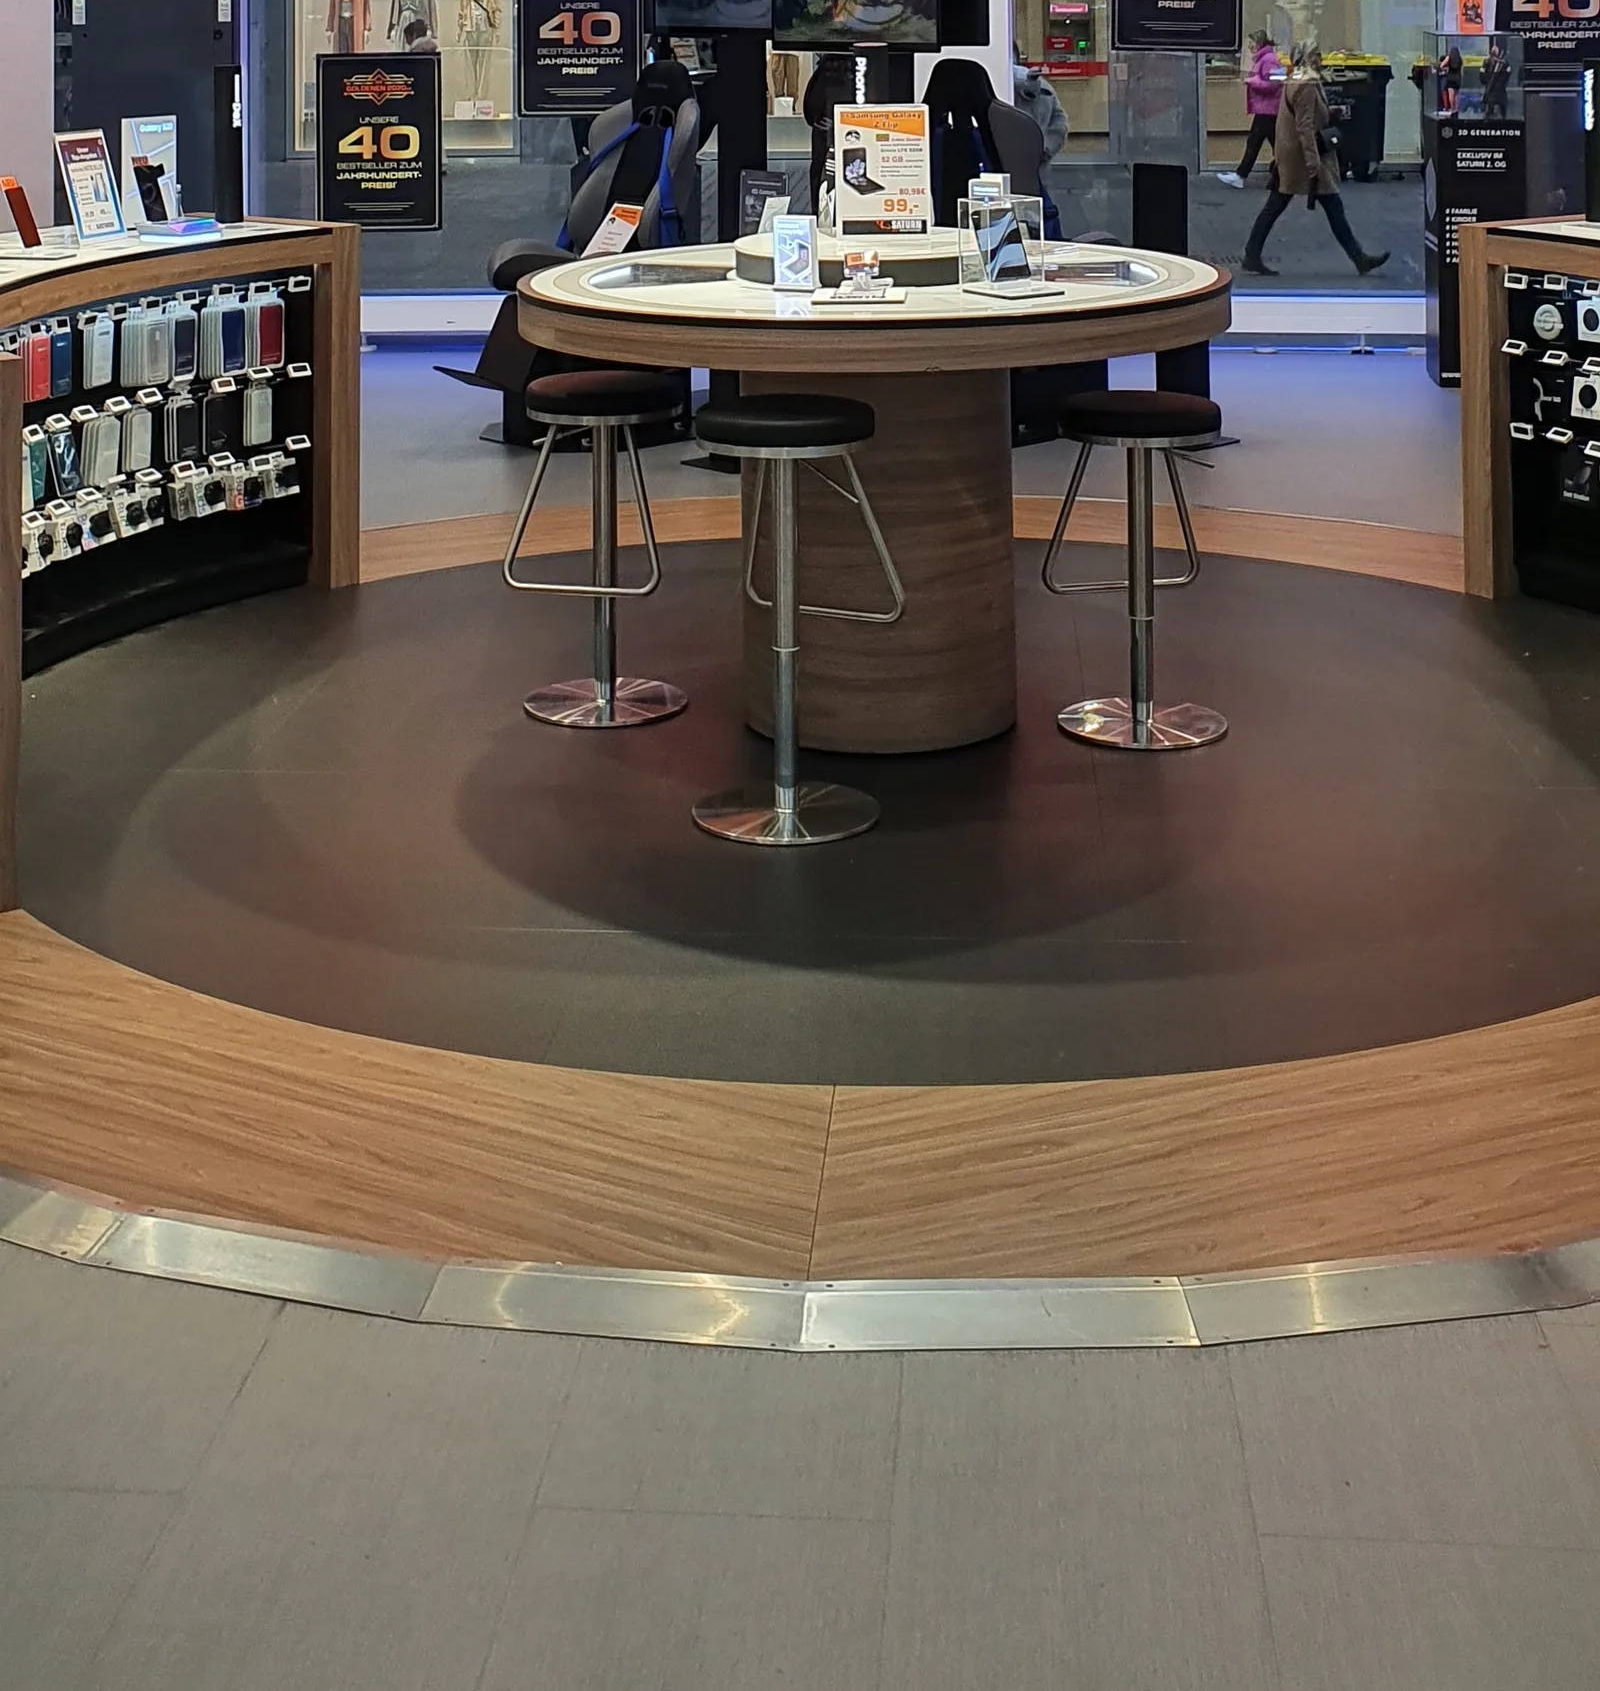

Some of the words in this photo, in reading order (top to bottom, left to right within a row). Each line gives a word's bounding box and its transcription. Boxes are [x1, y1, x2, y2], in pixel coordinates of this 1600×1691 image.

[560, 2, 600, 10] UNSERE
[539, 11, 621, 45] 40
[1510, 20, 1577, 29] BESTSELLER
[537, 47, 599, 55] BESTSELLER
[600, 47, 624, 55] ZUM
[537, 57, 624, 65] JAHRHUNDERT-
[359, 116, 399, 124] UNSERE
[338, 125, 421, 160] 40
[336, 162, 398, 170] BESTSELLER
[399, 161, 423, 169] ZUM
[336, 171, 423, 180] JAHRHUNDERT-
[891, 220, 922, 230] SATURN
